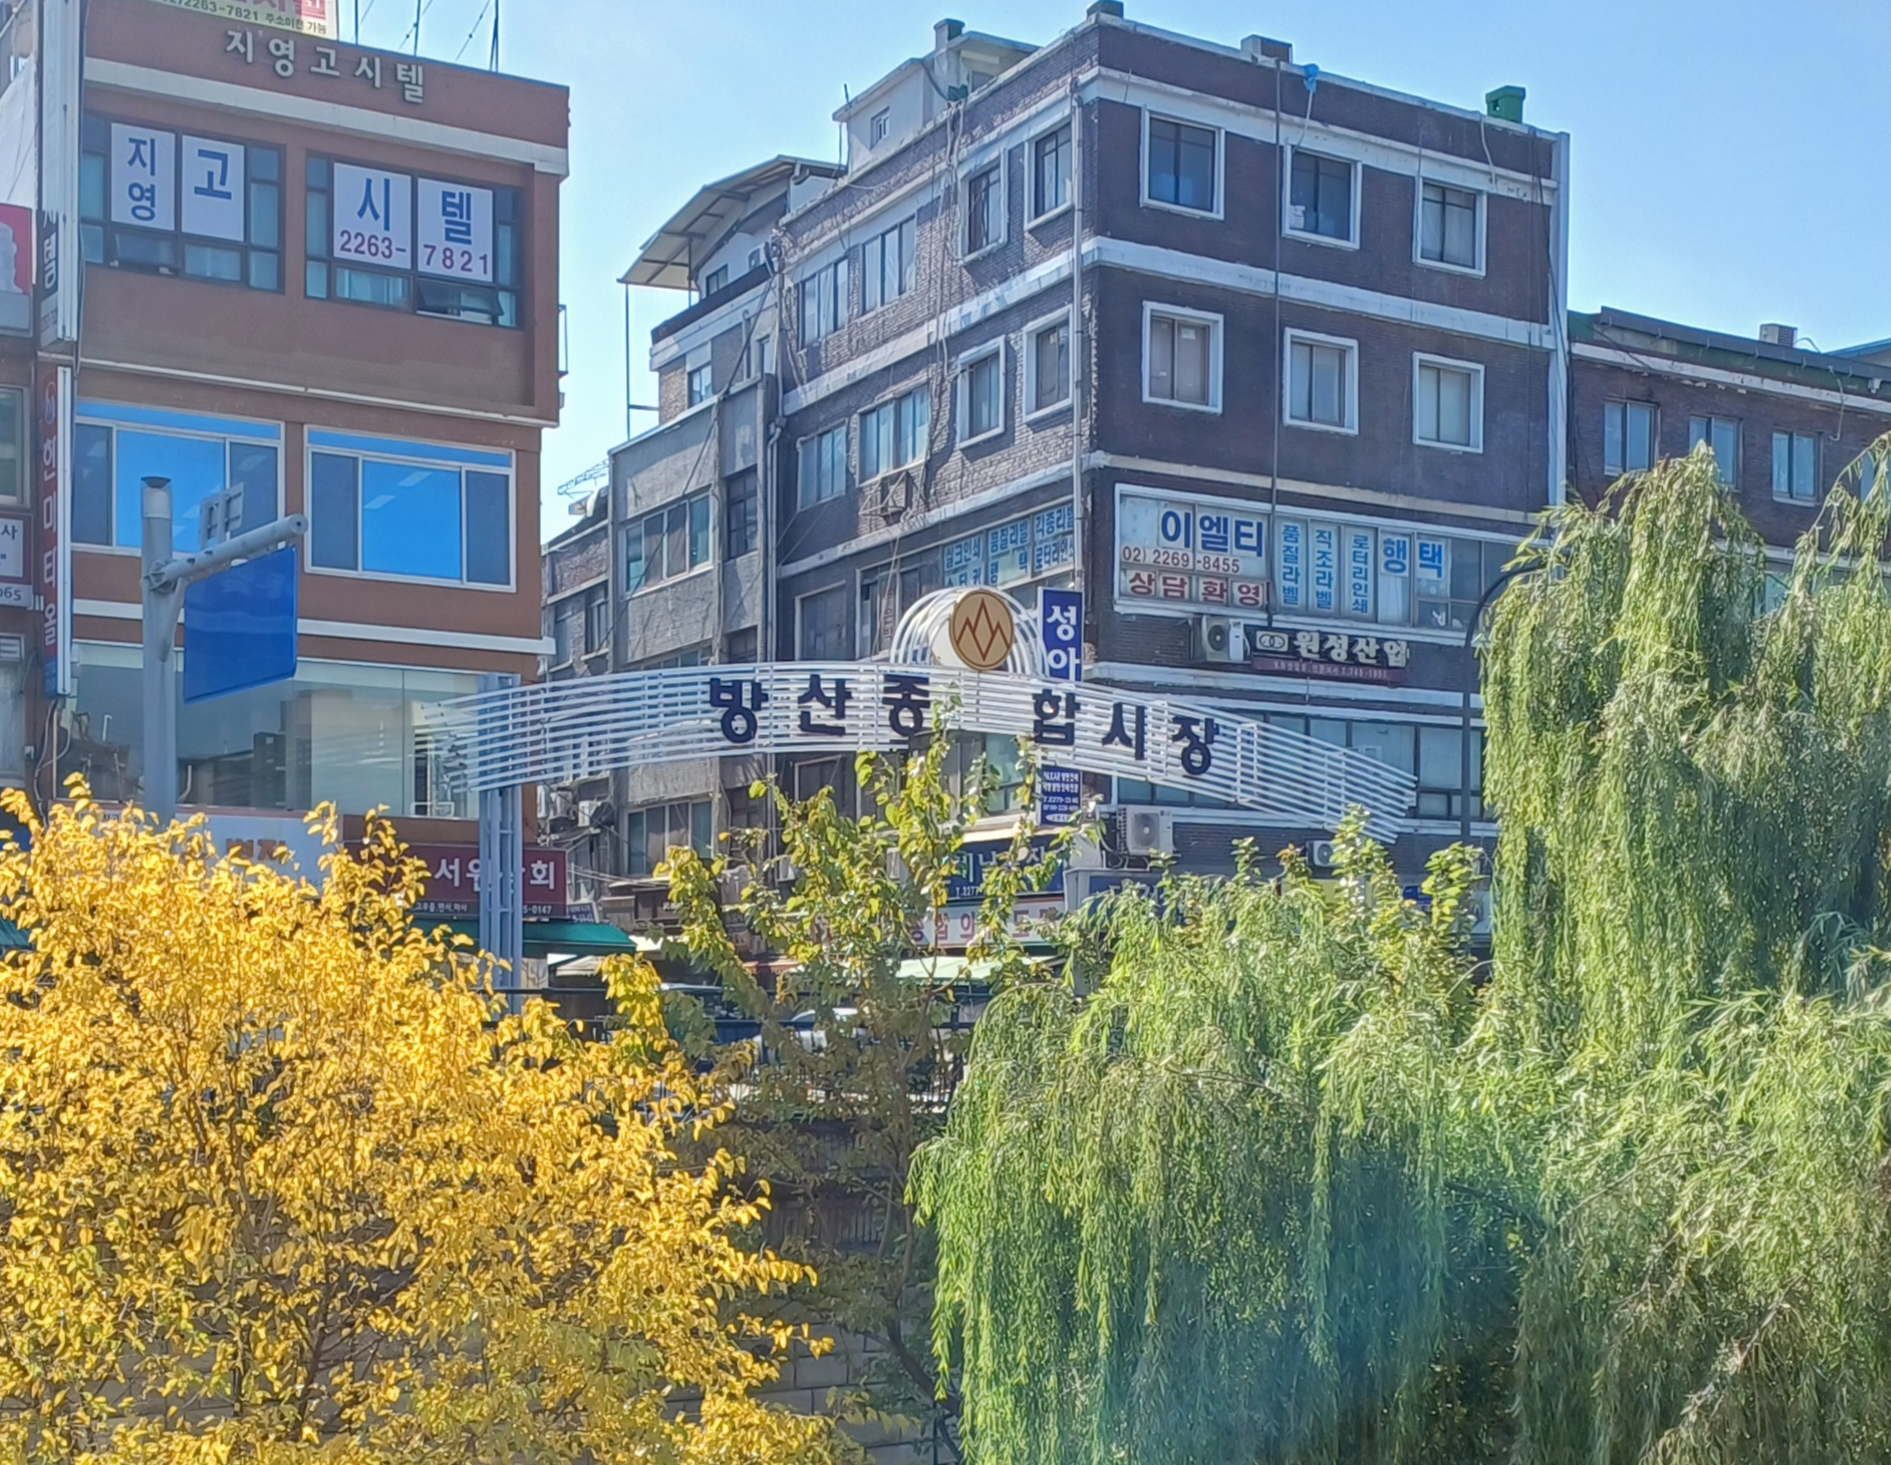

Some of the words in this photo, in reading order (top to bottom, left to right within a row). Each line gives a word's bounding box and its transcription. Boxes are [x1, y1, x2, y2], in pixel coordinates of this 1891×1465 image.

[226, 29, 424, 104] 지영고시텔
[307, 21, 327, 35] 가능
[127, 137, 156, 222] 지영
[1161, 511, 1263, 557] 이엘티
[1282, 524, 1300, 606] 품질라벨
[1316, 529, 1334, 610] 직조라벨
[1129, 572, 1187, 600] 상담
[1202, 580, 1260, 607] 환영
[1352, 534, 1370, 614] 로터리인쇄
[1294, 631, 1409, 668] 원성산업
[709, 673, 1220, 775] 방산종합시장
